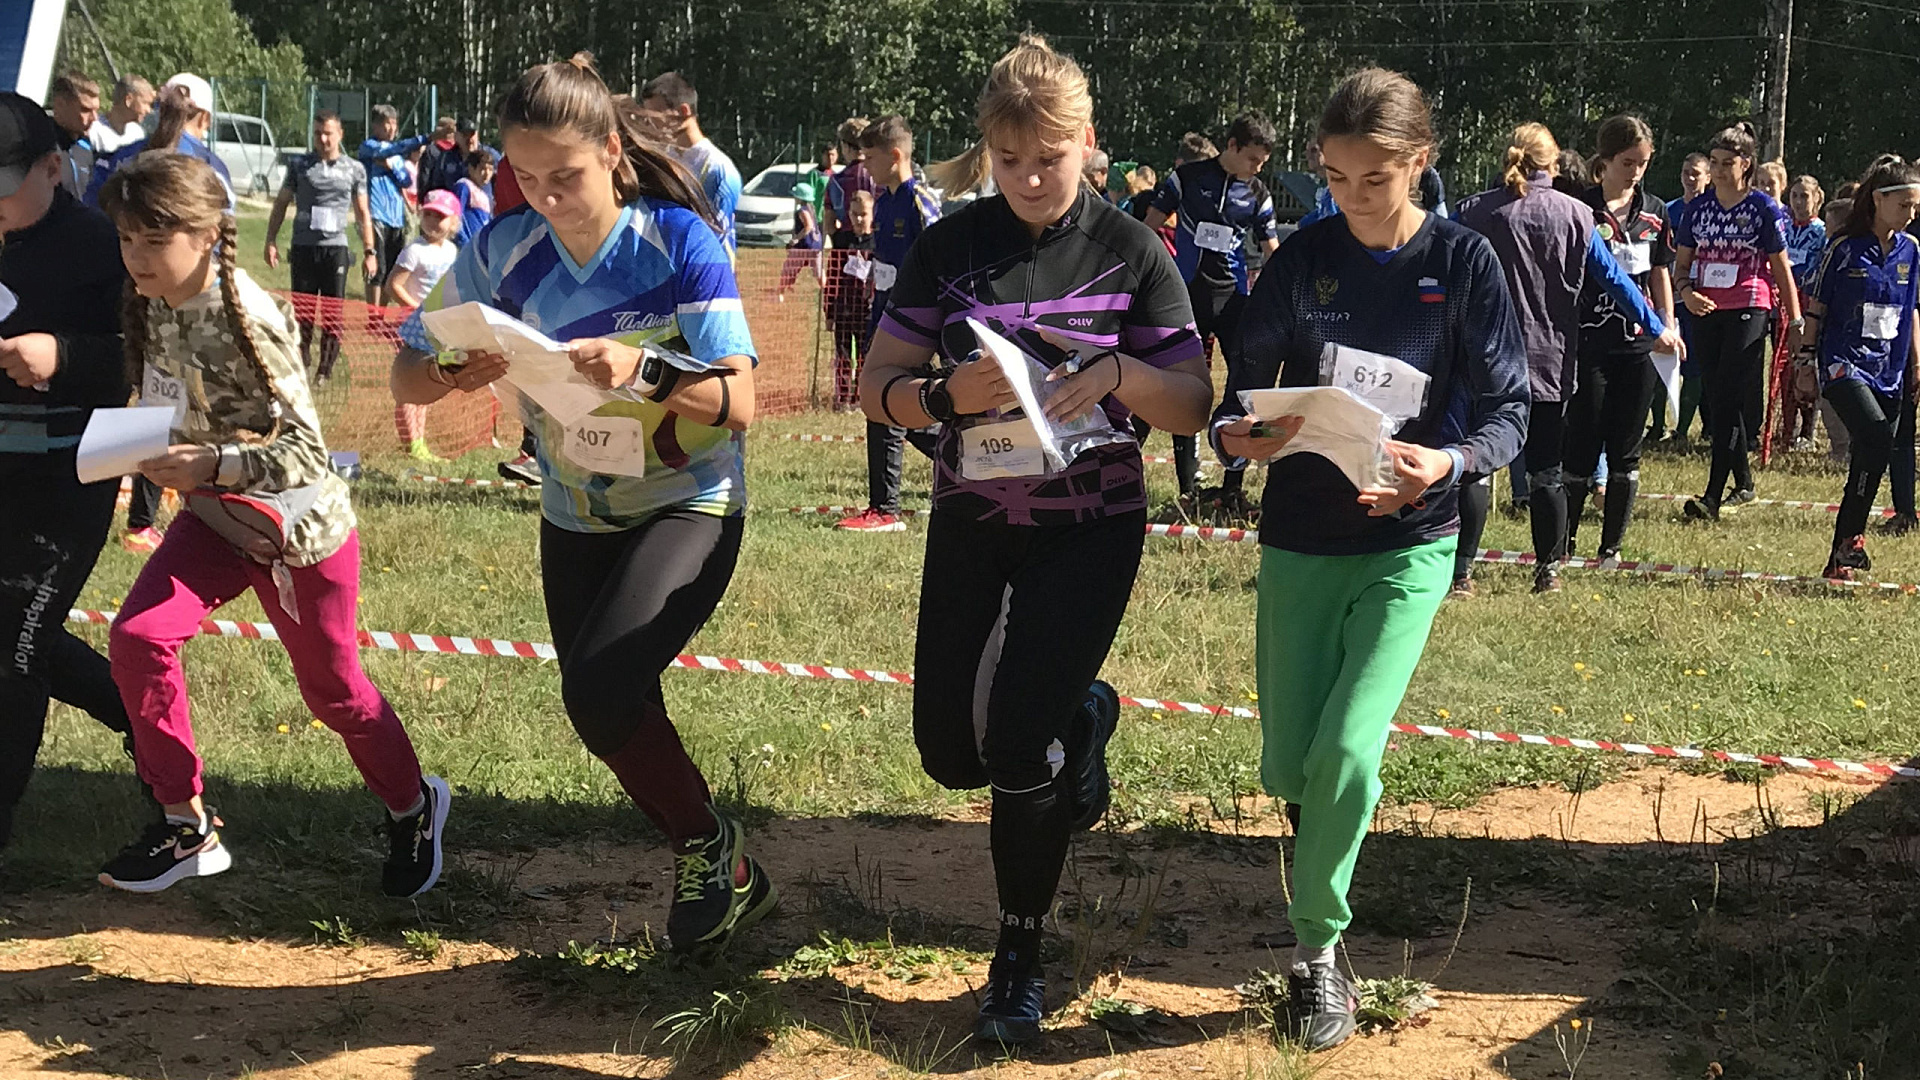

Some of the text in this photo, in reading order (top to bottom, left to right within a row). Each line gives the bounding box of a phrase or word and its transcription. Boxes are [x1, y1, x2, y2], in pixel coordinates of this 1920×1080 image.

[1067, 317, 1093, 327] OLLY
[1354, 366, 1393, 388] 612
[152, 376, 179, 400] 302
[577, 427, 611, 447] 407
[980, 437, 1014, 455] 108
[13, 584, 59, 674] inspiration
